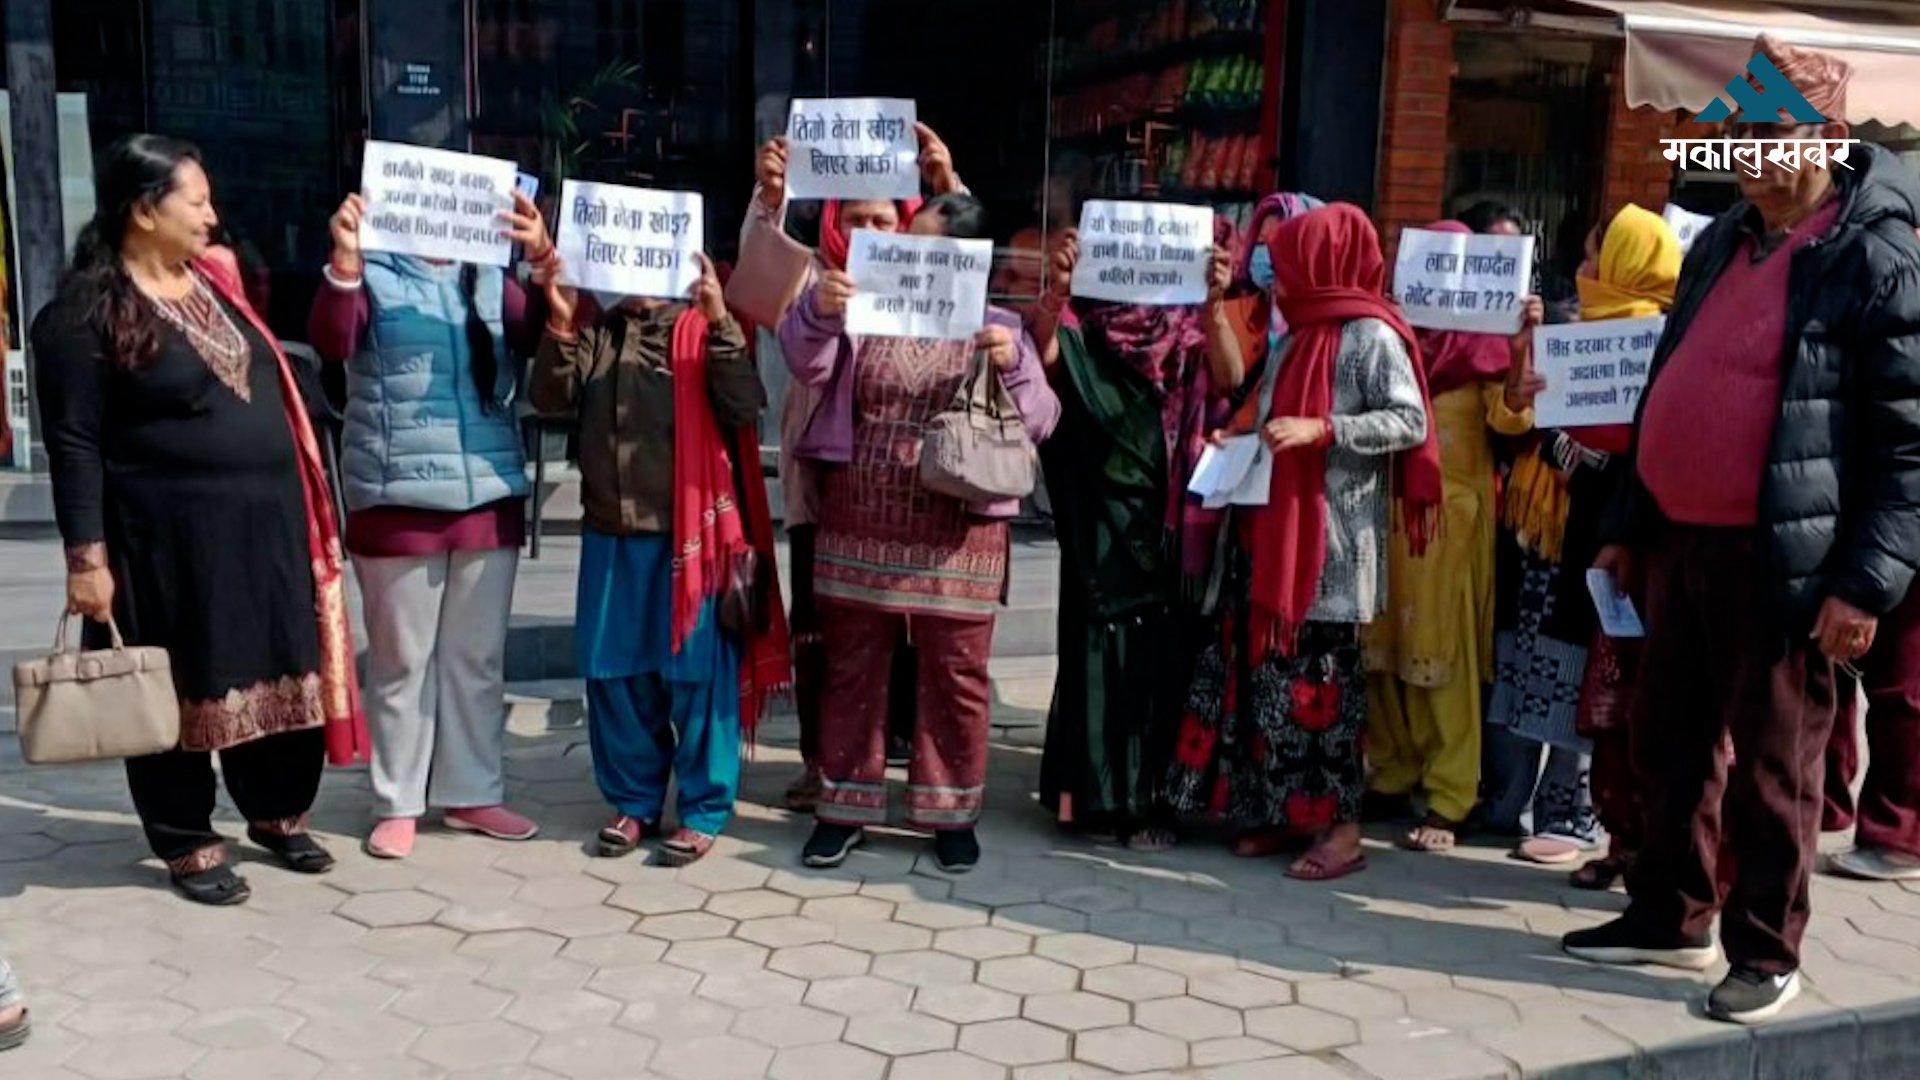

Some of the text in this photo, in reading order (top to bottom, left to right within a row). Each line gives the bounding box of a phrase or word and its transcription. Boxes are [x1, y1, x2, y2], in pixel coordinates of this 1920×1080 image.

[832, 112, 860, 140] नेता
[811, 148, 849, 174] लिएर
[613, 201, 643, 230] नेता
[585, 234, 627, 266] लिएर
[1426, 252, 1459, 273] लाज
[1405, 280, 1433, 307] भोट
[1484, 289, 1515, 310] ???
[1617, 337, 1625, 352] र
